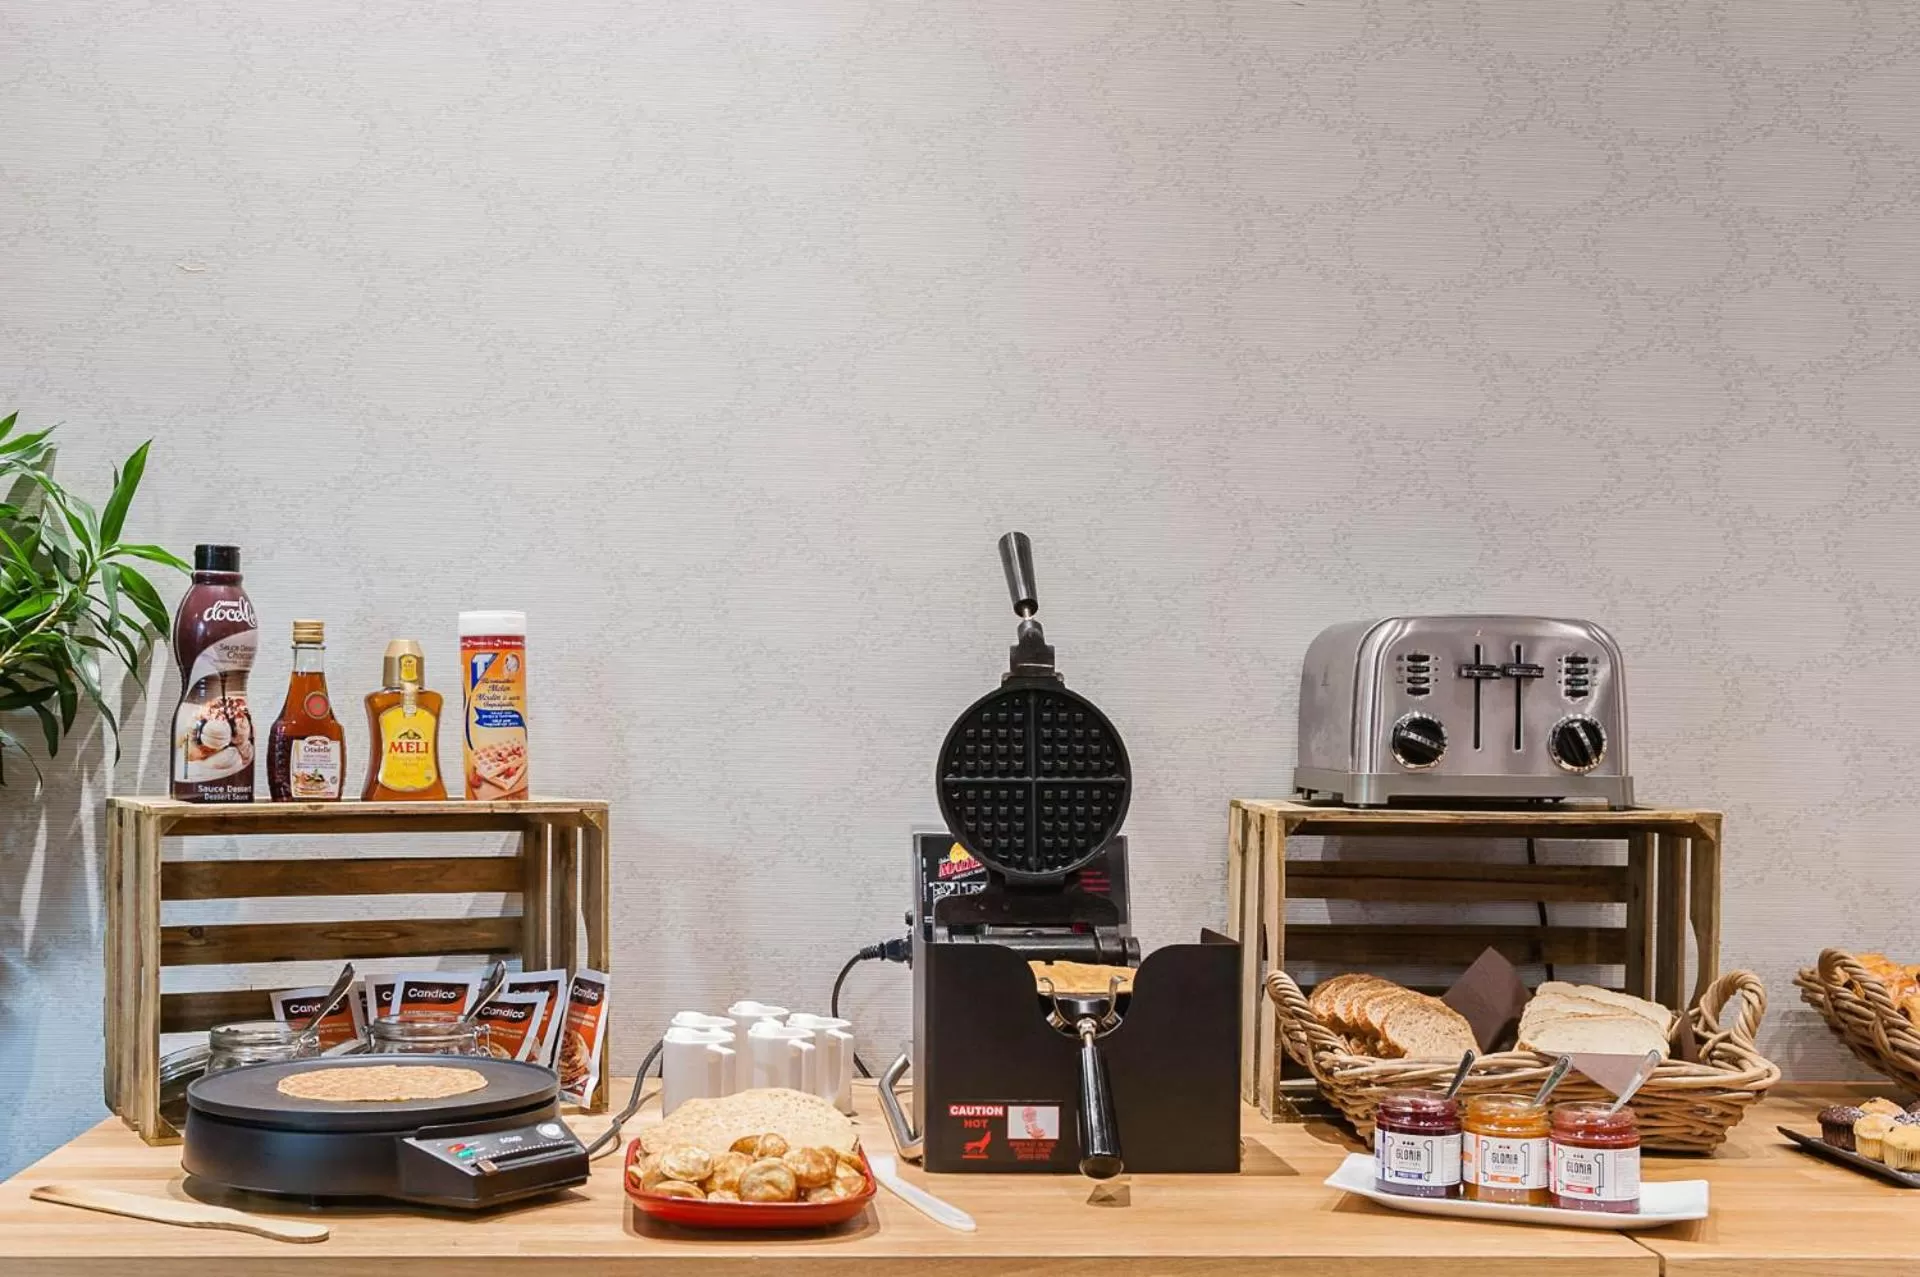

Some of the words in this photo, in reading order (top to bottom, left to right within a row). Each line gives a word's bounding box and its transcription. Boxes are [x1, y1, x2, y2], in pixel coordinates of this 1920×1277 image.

[387, 742, 429, 754] MELI
[198, 784, 225, 793] Sauce
[227, 784, 252, 793] Dessert
[205, 793, 231, 801] Dessert
[233, 794, 249, 802] Sauce
[407, 988, 457, 999] Candico
[573, 985, 599, 1001] Candico
[289, 1002, 340, 1014] Cando
[481, 1006, 526, 1018] Candico
[949, 1105, 1004, 1117] CAUTION
[963, 1119, 989, 1129] HOT
